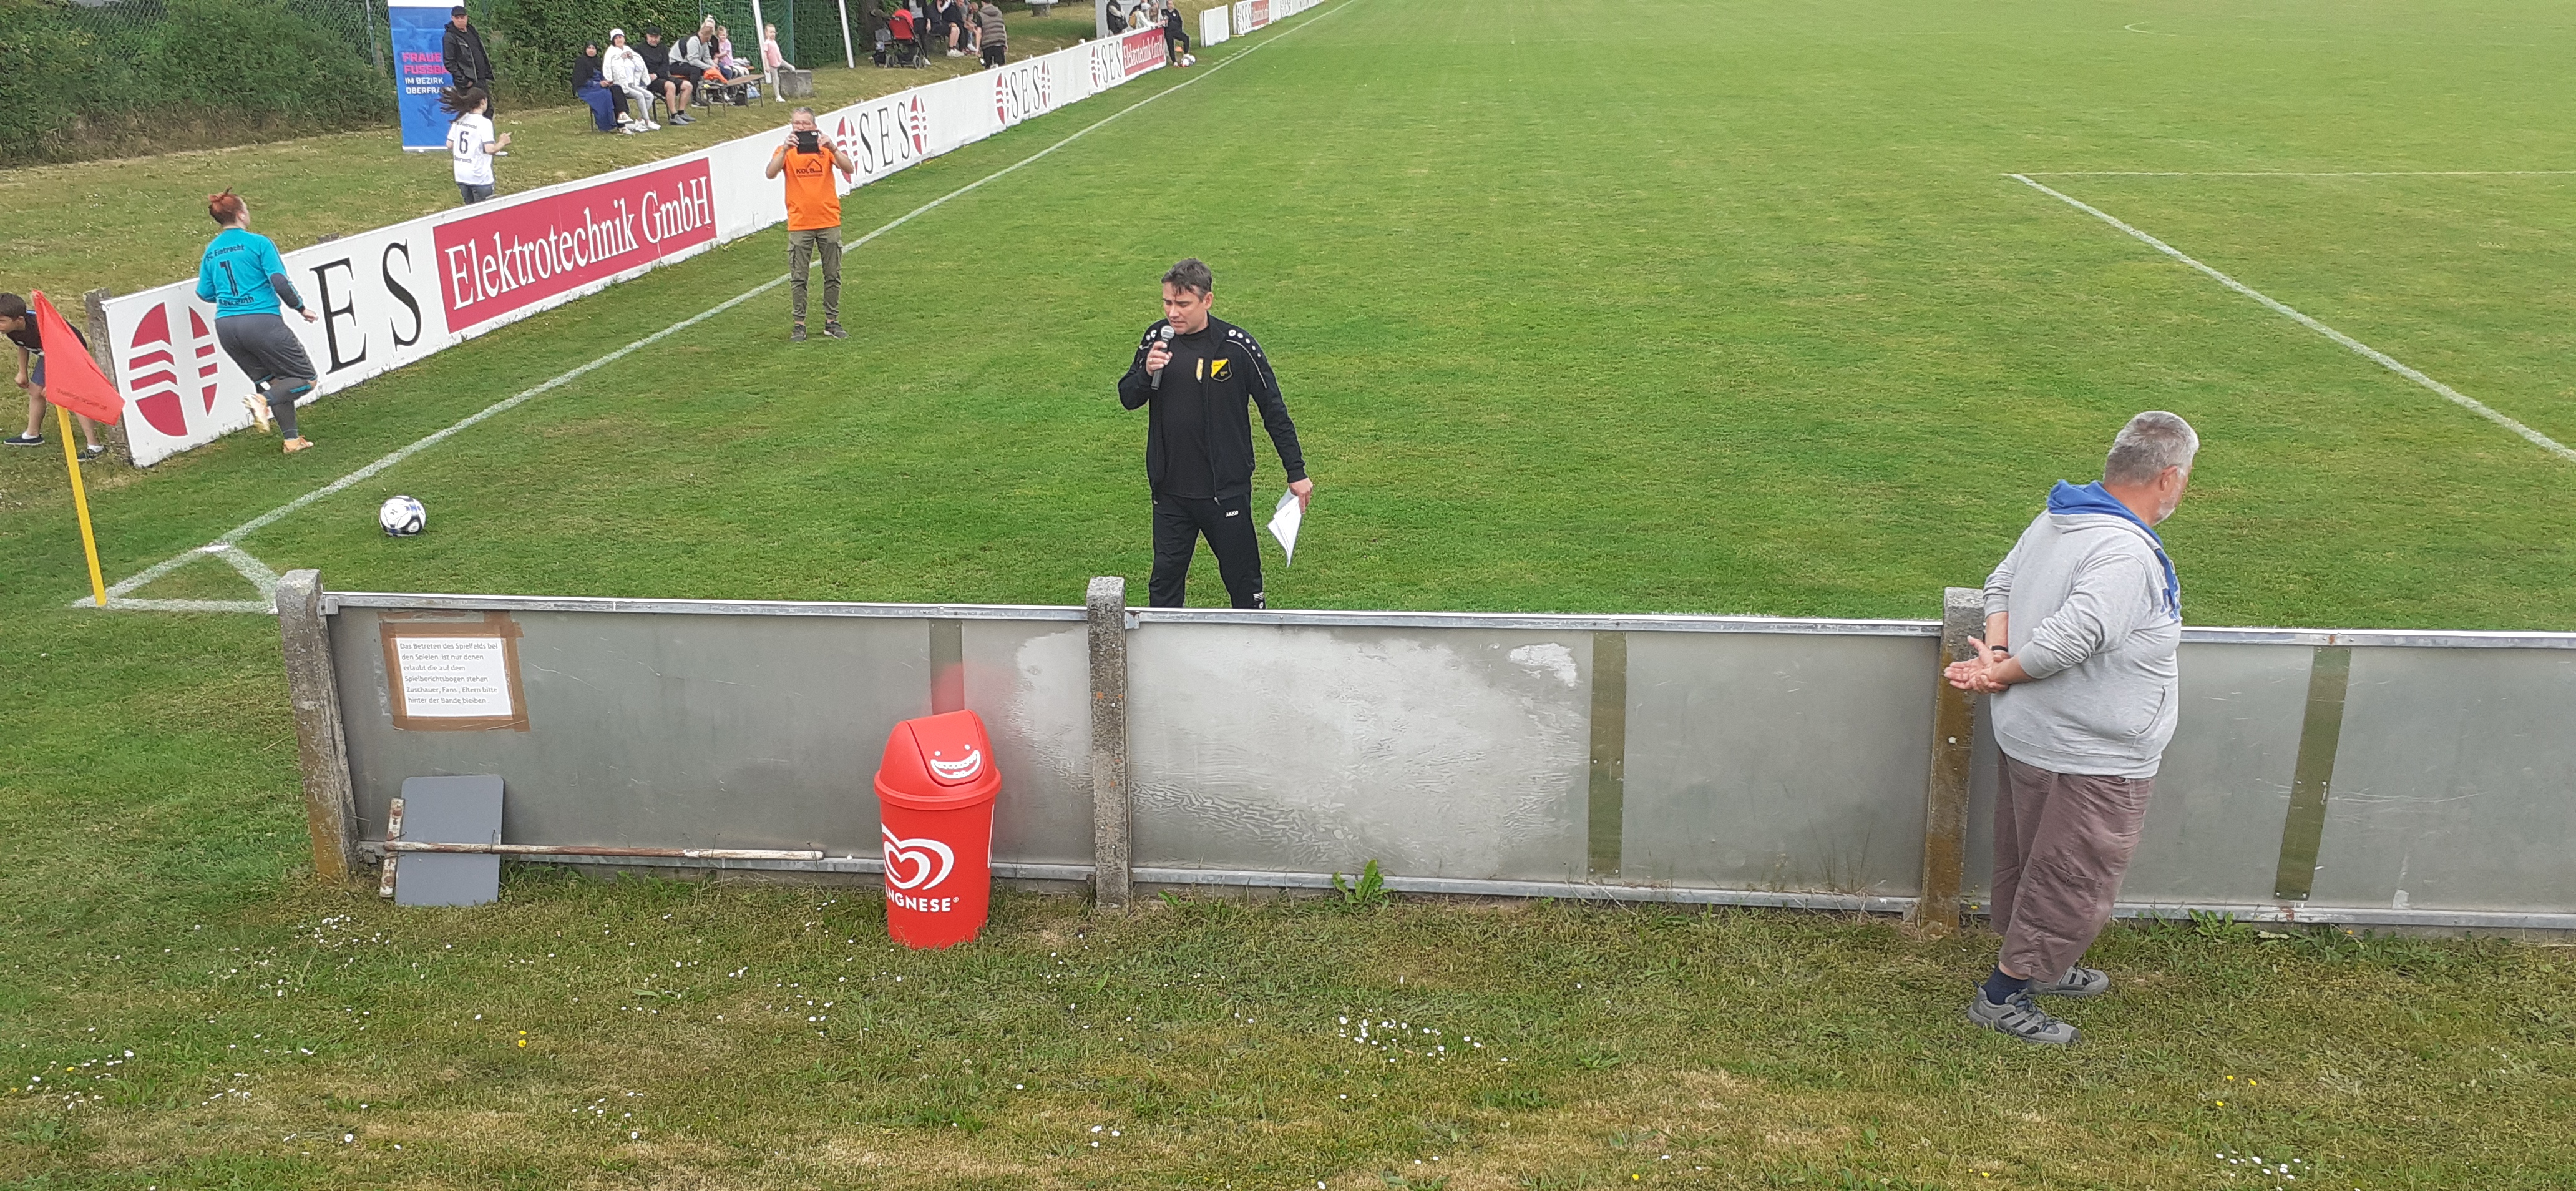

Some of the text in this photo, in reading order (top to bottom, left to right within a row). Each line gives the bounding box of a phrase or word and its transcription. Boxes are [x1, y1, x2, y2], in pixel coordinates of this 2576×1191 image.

[402, 52, 442, 62] FRAUE
[404, 64, 449, 74] FUSSBA
[1101, 41, 1122, 83] SES
[1010, 65, 1040, 119] SES
[459, 130, 469, 154] 6
[859, 101, 910, 174] SES
[214, 243, 245, 257] Eintracht
[445, 177, 712, 310] Elektrotechnik GmbH
[220, 260, 238, 297] 1
[309, 238, 422, 375] ES
[885, 883, 950, 912] NGNESE
